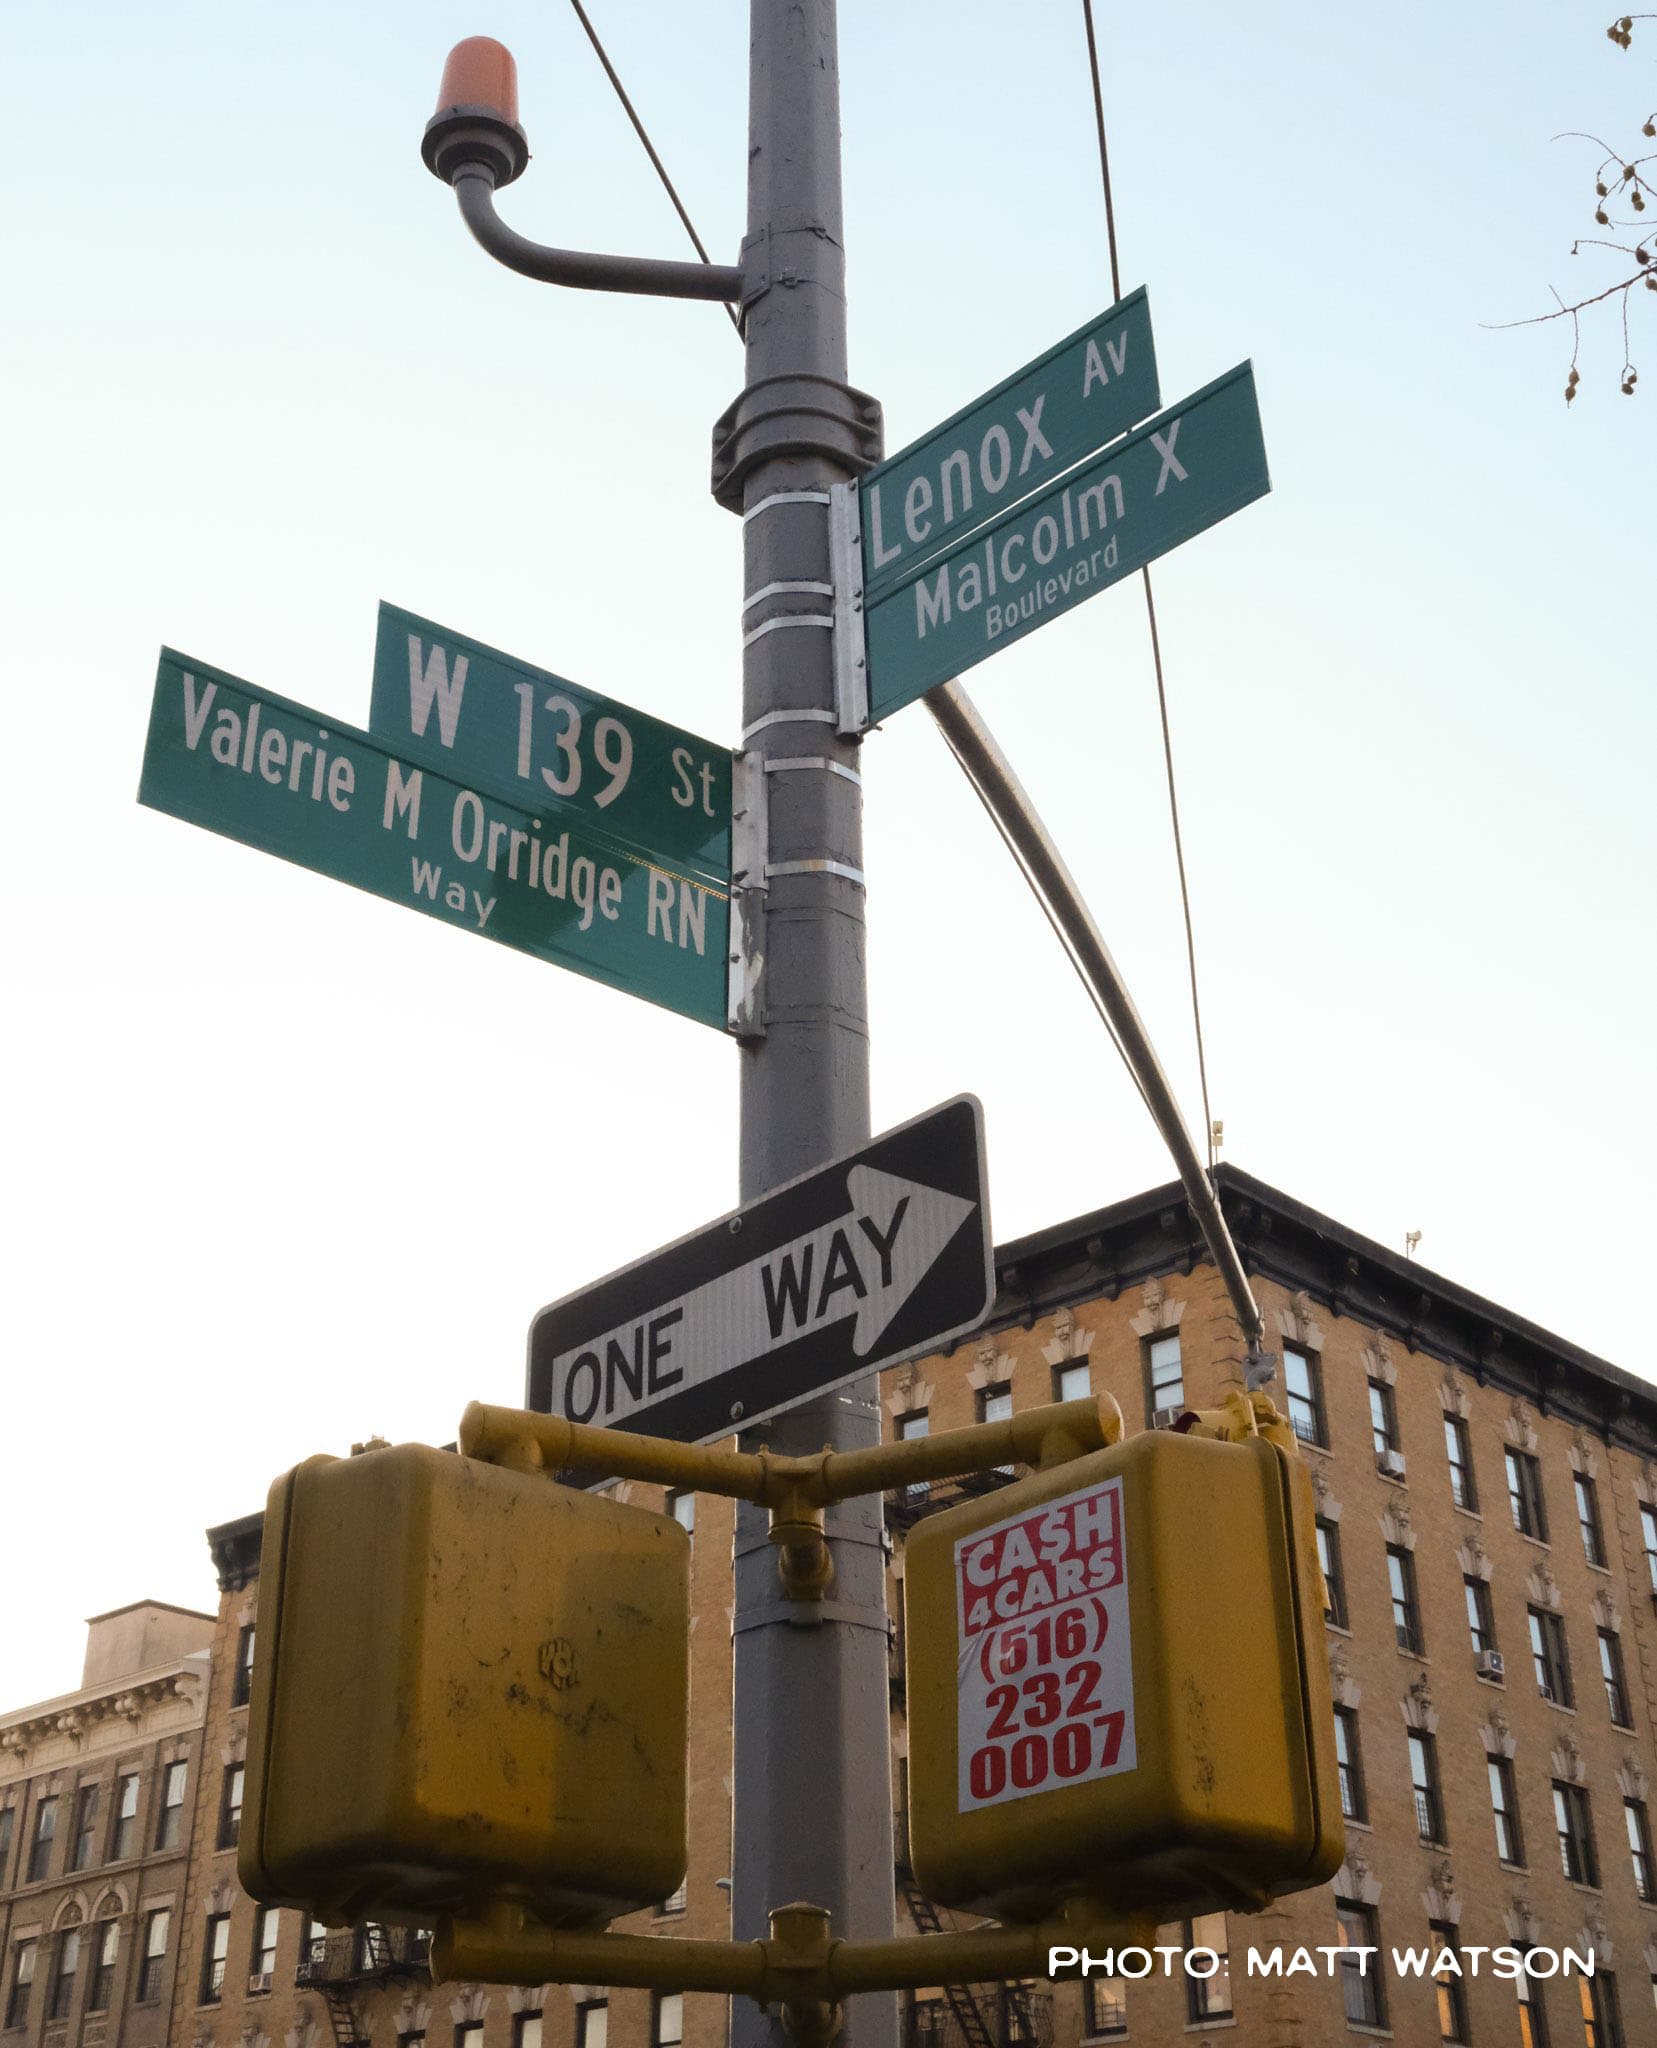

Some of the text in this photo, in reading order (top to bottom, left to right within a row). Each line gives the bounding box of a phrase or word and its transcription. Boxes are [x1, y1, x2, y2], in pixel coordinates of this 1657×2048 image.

[869, 330, 1128, 570] Lenox Av
[914, 417, 1189, 639] Malcolm X
[985, 535, 1119, 641] Boulevard
[407, 634, 716, 818] W 139 St
[183, 672, 706, 956] Valerie M Orridge RN
[411, 855, 498, 929] Way
[564, 1194, 912, 1425] ONE WAY
[979, 1597, 1110, 1685] (516)
[985, 1660, 1103, 1740] 232
[969, 1710, 1126, 1799] 0007
